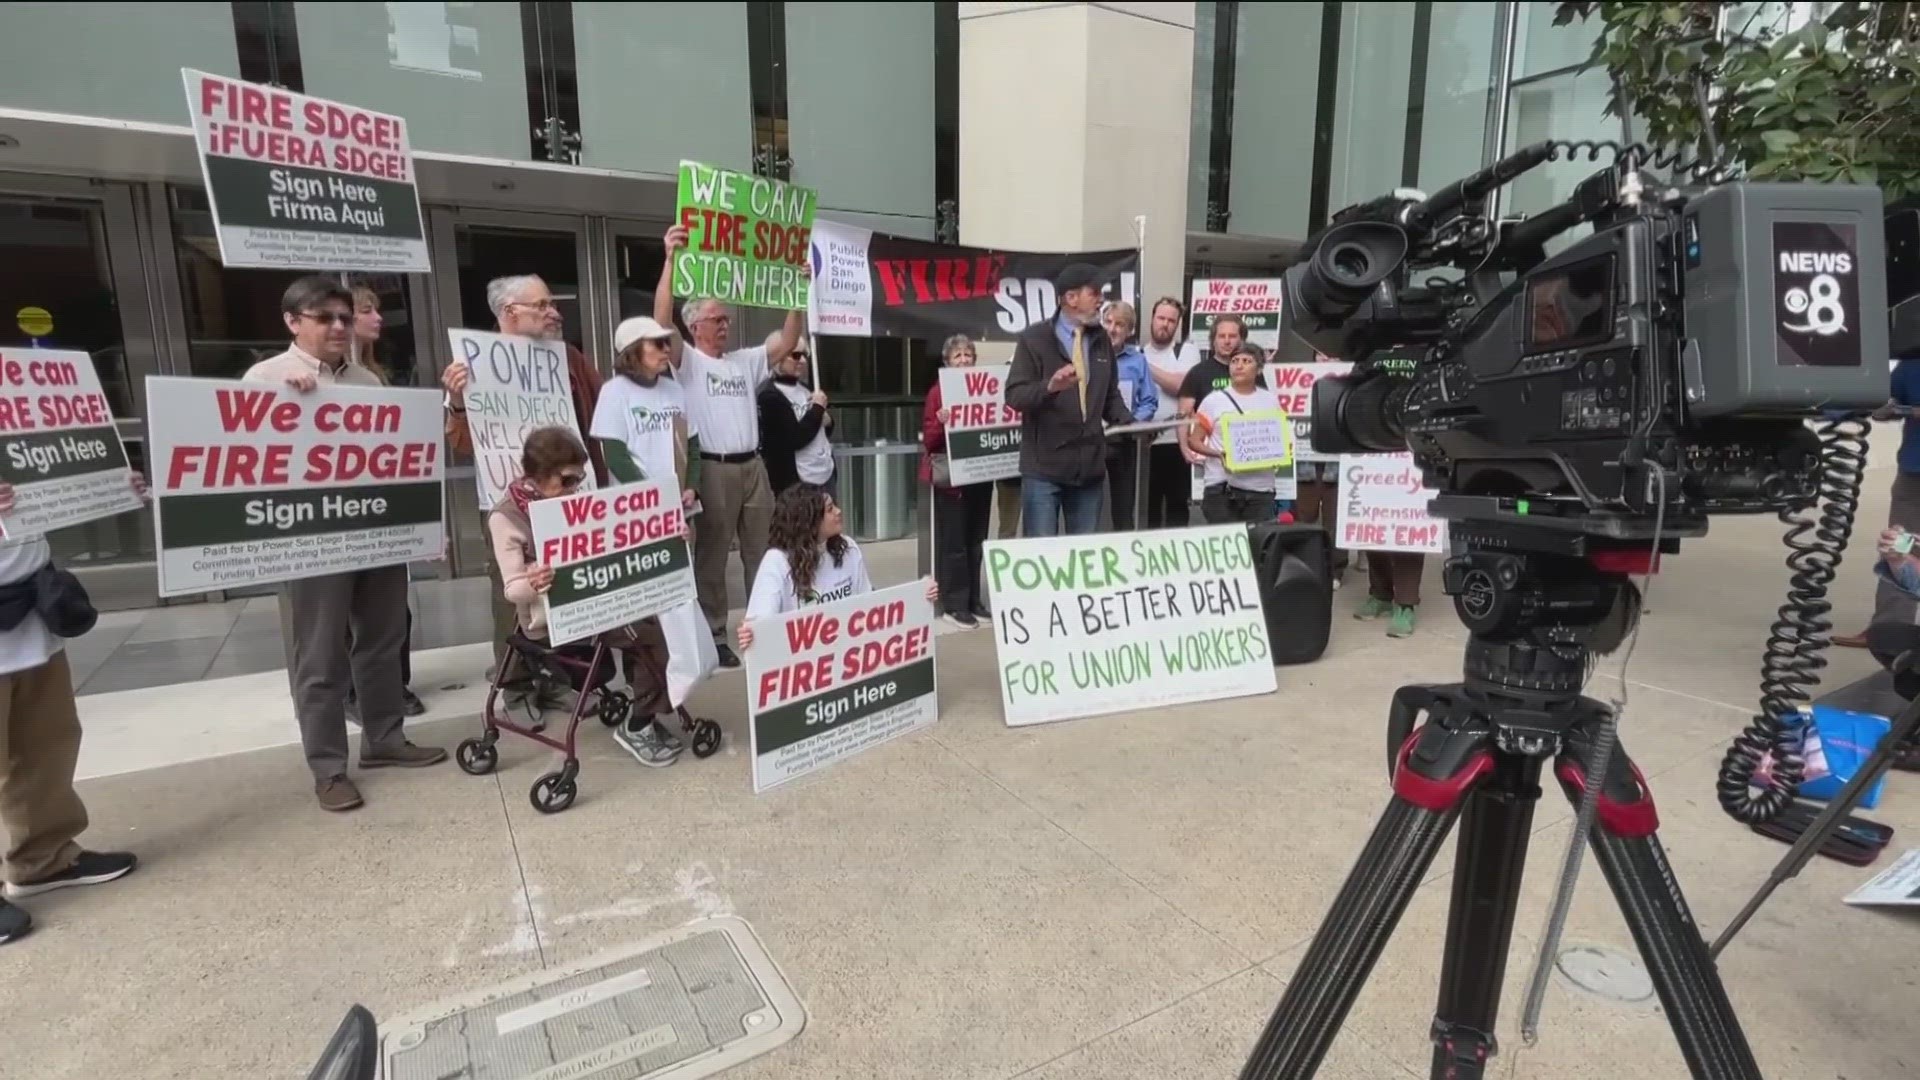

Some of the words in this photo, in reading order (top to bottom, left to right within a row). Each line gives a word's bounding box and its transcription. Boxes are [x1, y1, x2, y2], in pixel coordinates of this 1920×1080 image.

[201, 77, 293, 130] FIRE
[304, 100, 400, 151] SDGE!
[334, 144, 406, 180] SDGE!
[269, 169, 324, 200] Sign
[328, 176, 378, 204] Here
[690, 166, 738, 210] WE
[750, 179, 808, 225] CAN
[267, 195, 338, 224] Firma
[341, 205, 385, 232] Aquí
[681, 207, 748, 257] FIRE
[753, 219, 812, 266] SDGE
[830, 241, 865, 258] Public
[830, 254, 865, 269] Power
[831, 265, 854, 278] San
[1780, 252, 1852, 273] NEWS
[677, 252, 747, 301] SIGN
[752, 264, 809, 308] HERE
[831, 278, 866, 293] Diego
[874, 254, 1006, 306] FIRE
[1209, 281, 1233, 295] We
[1237, 283, 1268, 295] can
[1193, 298, 1228, 312] FIRE
[1231, 298, 1280, 312] SDGE!
[1807, 273, 1845, 336] 8
[29, 360, 78, 386] can
[462, 338, 566, 397] POWER
[965, 371, 999, 397] We
[1274, 368, 1314, 389] We
[0, 396, 35, 431] RE
[37, 394, 109, 428] SDGE!
[216, 389, 301, 434] We
[314, 401, 402, 434] can
[467, 392, 510, 418] SAN
[517, 395, 570, 426] DIEGO
[950, 402, 997, 428] FIRE
[1278, 394, 1308, 413] RE
[471, 419, 528, 451] WELC
[980, 433, 1008, 450] Sign
[6, 440, 62, 474] Sign
[60, 436, 107, 464] Here
[167, 445, 293, 490] FIRE
[303, 443, 437, 483] SDGE!
[1347, 465, 1421, 495] Greedy
[245, 499, 314, 530] Sign
[322, 496, 388, 520] Here
[561, 495, 607, 527] We
[614, 487, 660, 516] can
[203, 545, 228, 557] Paid
[230, 544, 245, 554] for
[247, 544, 259, 554] by
[262, 540, 293, 551] Power
[543, 528, 606, 566] FIRE
[613, 508, 682, 549] SDGE!
[1345, 523, 1387, 545] FIRE
[1391, 523, 1438, 547] 'EM!
[192, 556, 251, 571] Committee
[284, 548, 318, 559] funding
[213, 568, 255, 581] Funding
[572, 562, 622, 591] Sign
[625, 549, 671, 576] Here
[989, 546, 1129, 593] POWER
[1131, 539, 1181, 577] SAN
[1183, 532, 1251, 575] DIEGO
[786, 613, 840, 654] We
[847, 600, 905, 638] can
[1000, 607, 1030, 645] IS
[1049, 601, 1068, 638] A
[1077, 583, 1182, 635] BETTER
[1189, 577, 1259, 616] DEAL
[758, 653, 834, 709] FIRE
[840, 624, 929, 681] SDGE!
[1004, 660, 1059, 705] FOR
[1069, 641, 1151, 689] UNION
[1160, 622, 1268, 676] WORKERS
[805, 697, 849, 725] Sign
[854, 680, 897, 708] Here
[545, 1031, 666, 1080] MMUNICATIONS
